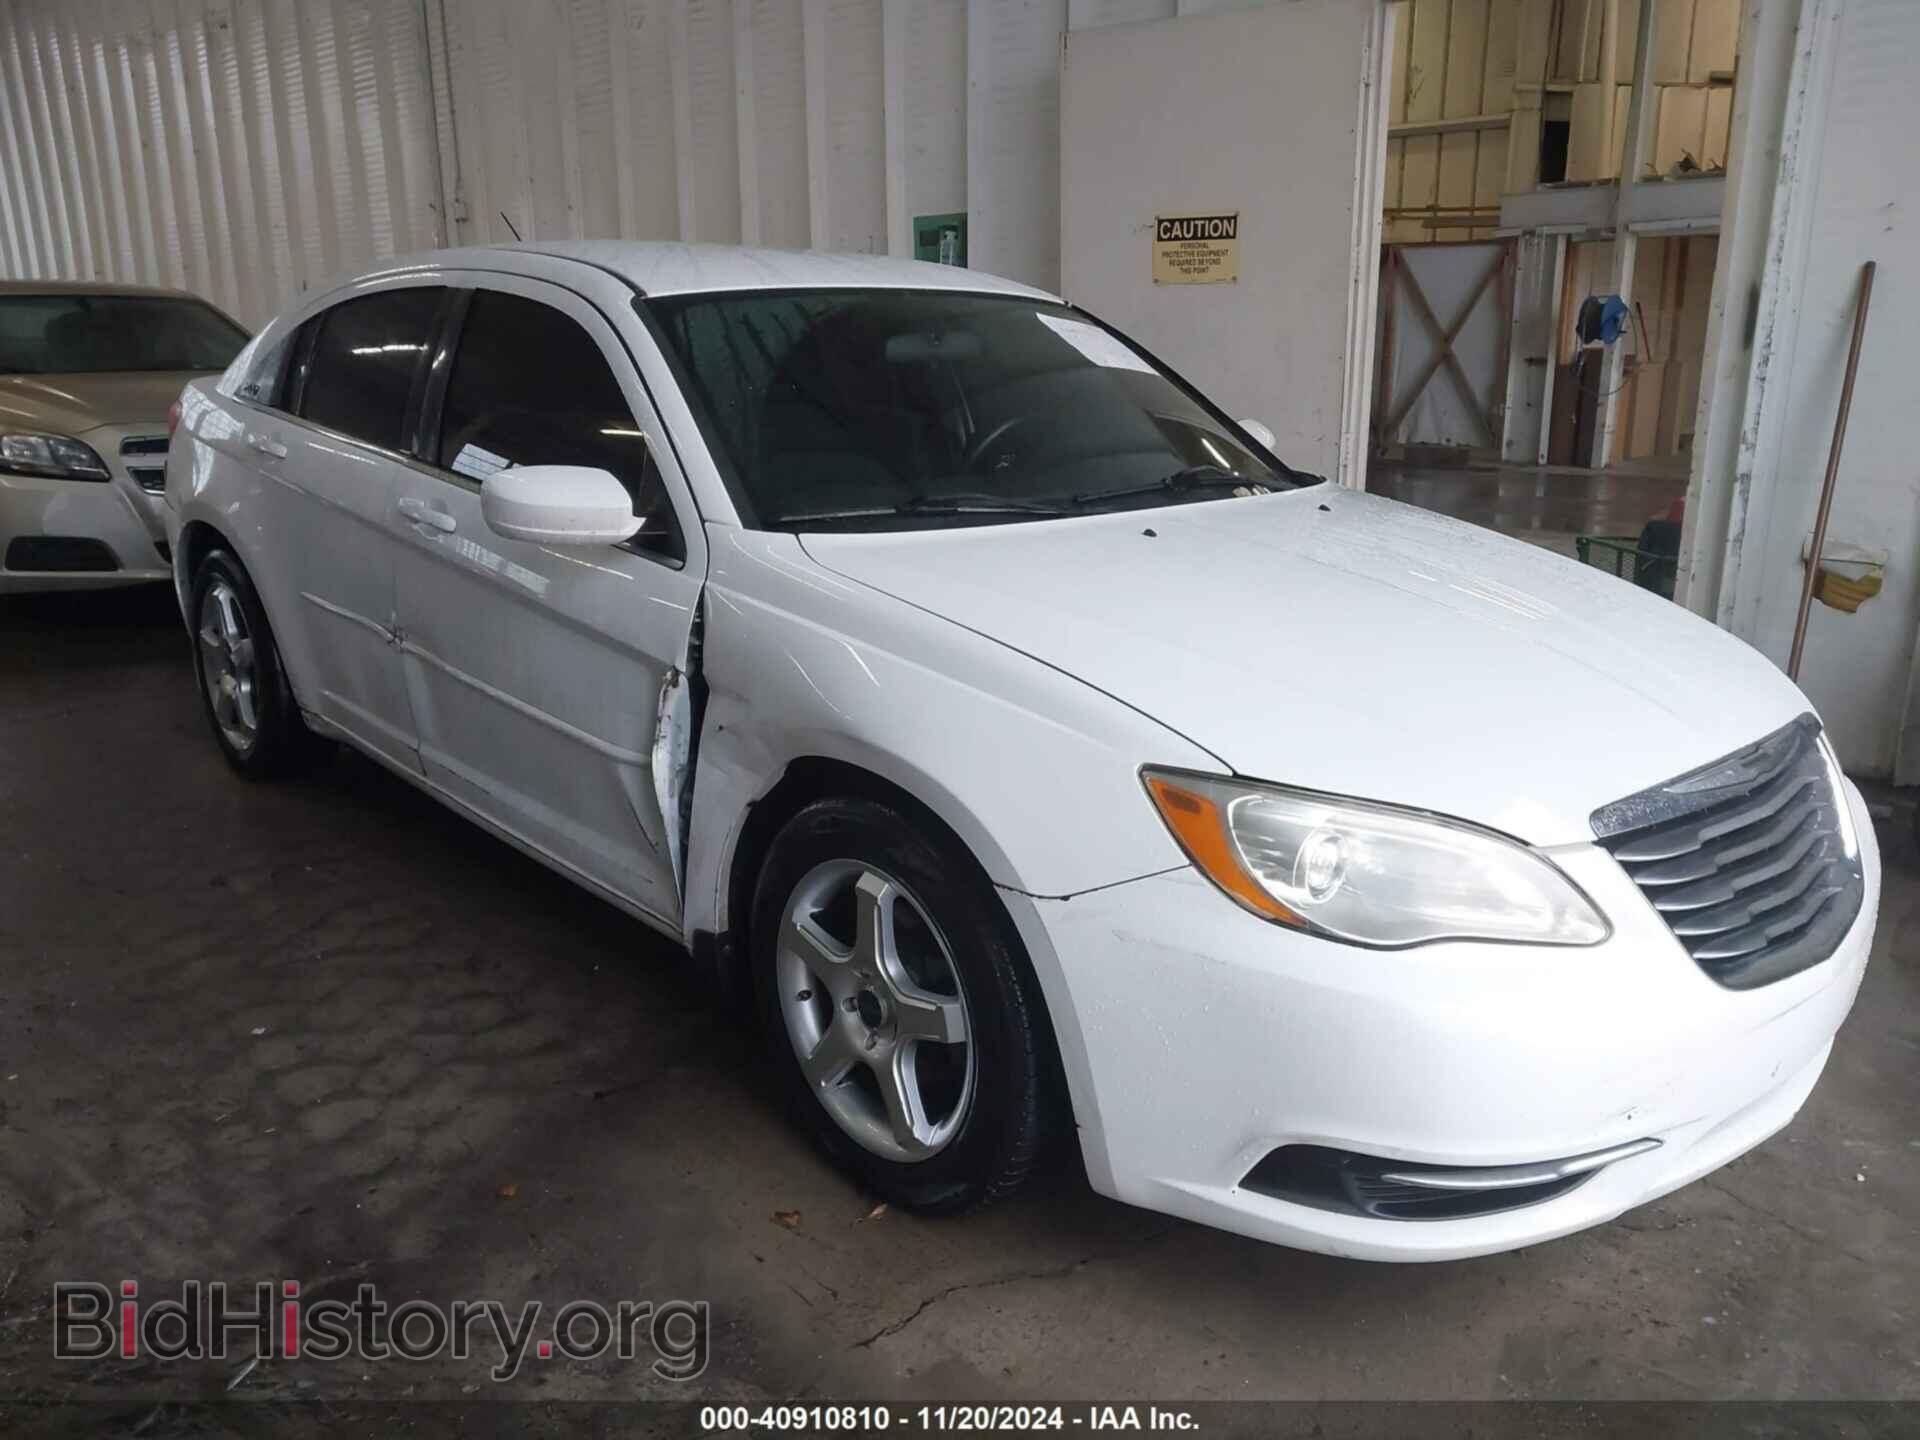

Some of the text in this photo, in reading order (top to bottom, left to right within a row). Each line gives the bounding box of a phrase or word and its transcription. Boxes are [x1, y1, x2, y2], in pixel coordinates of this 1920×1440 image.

[1159, 218, 1235, 239] CAUTION
[1169, 257, 1221, 267] REQUIRED BEYOND
